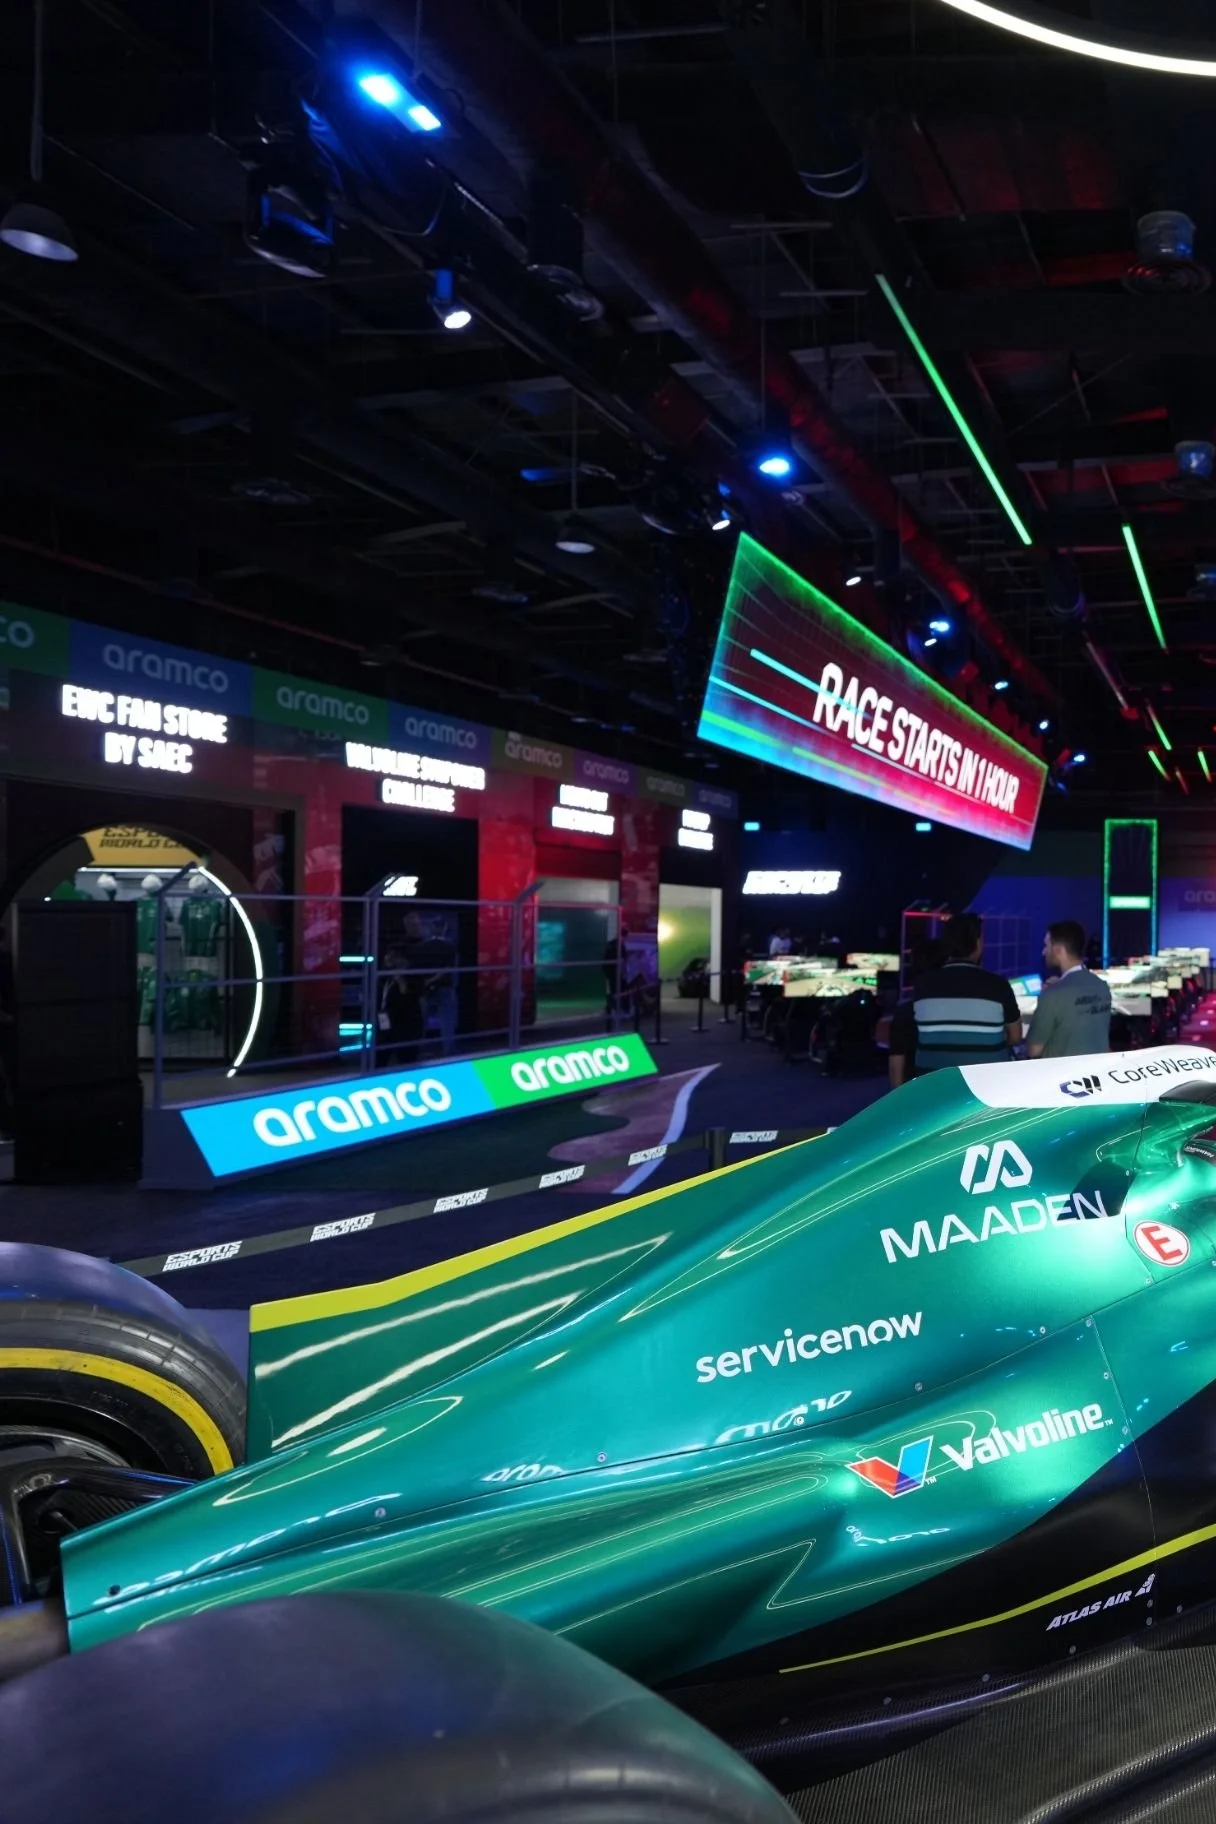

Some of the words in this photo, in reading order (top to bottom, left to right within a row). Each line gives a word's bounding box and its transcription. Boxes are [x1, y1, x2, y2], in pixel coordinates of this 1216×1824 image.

[103, 643, 229, 693] aramco
[61, 684, 115, 723] EWC
[117, 695, 162, 732] FAN
[163, 704, 228, 743] STORE
[276, 685, 370, 724] aramco
[104, 731, 137, 766] BY
[404, 716, 477, 749] aramco
[813, 662, 893, 753] RACE
[887, 706, 962, 786] STARTS
[957, 747, 980, 795] IN
[974, 757, 987, 799] 1
[981, 761, 1019, 814] HOUR
[505, 738, 563, 769] aramco
[583, 760, 630, 785] aramco
[511, 1043, 629, 1092] aramco
[252, 1077, 452, 1147] aramco
[313, 1213, 376, 1234] ESPORTS
[879, 1190, 1109, 1264] MAADEN
[162, 1255, 212, 1272] WORLD
[211, 1249, 239, 1262] CUP
[166, 1240, 243, 1263] ESPORTS
[696, 1311, 922, 1383] servicenow
[940, 1402, 1102, 1472] Valvoline
[1046, 1601, 1103, 1631] ATLAS
[1102, 1590, 1133, 1610] AIR
